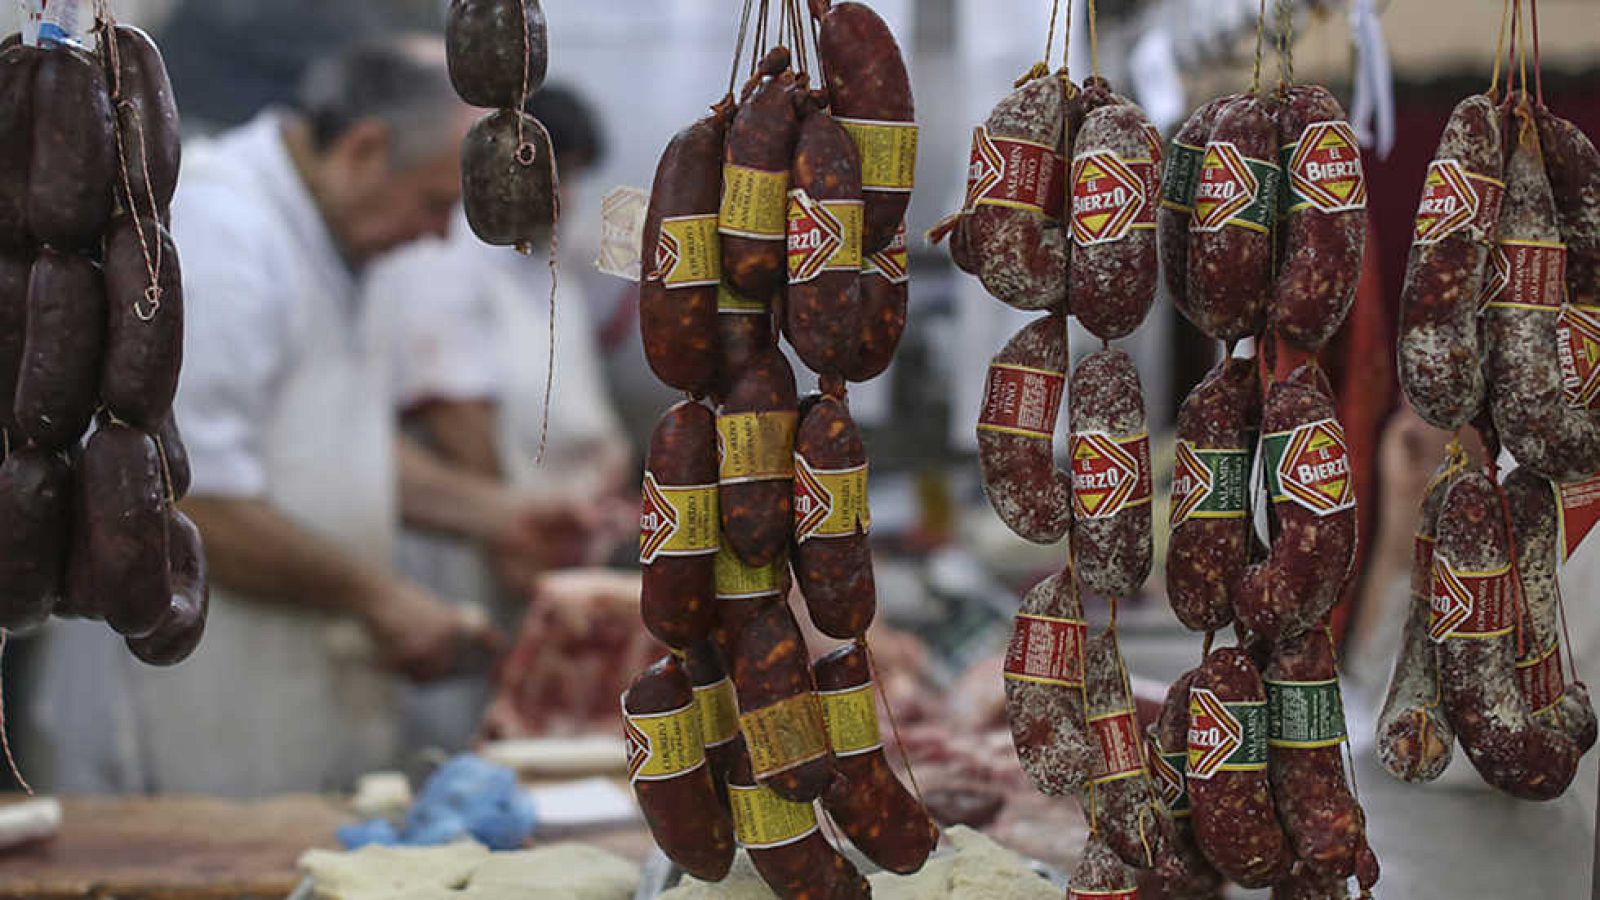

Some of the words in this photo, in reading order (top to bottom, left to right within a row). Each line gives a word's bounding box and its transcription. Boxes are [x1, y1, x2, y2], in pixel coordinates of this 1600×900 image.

[1007, 144, 1023, 199] SALAMIN
[1025, 158, 1037, 190] FINO
[1004, 382, 1017, 415] FINO
[1219, 456, 1229, 511] SALAMIN
[1248, 708, 1258, 761] SALAMIN
